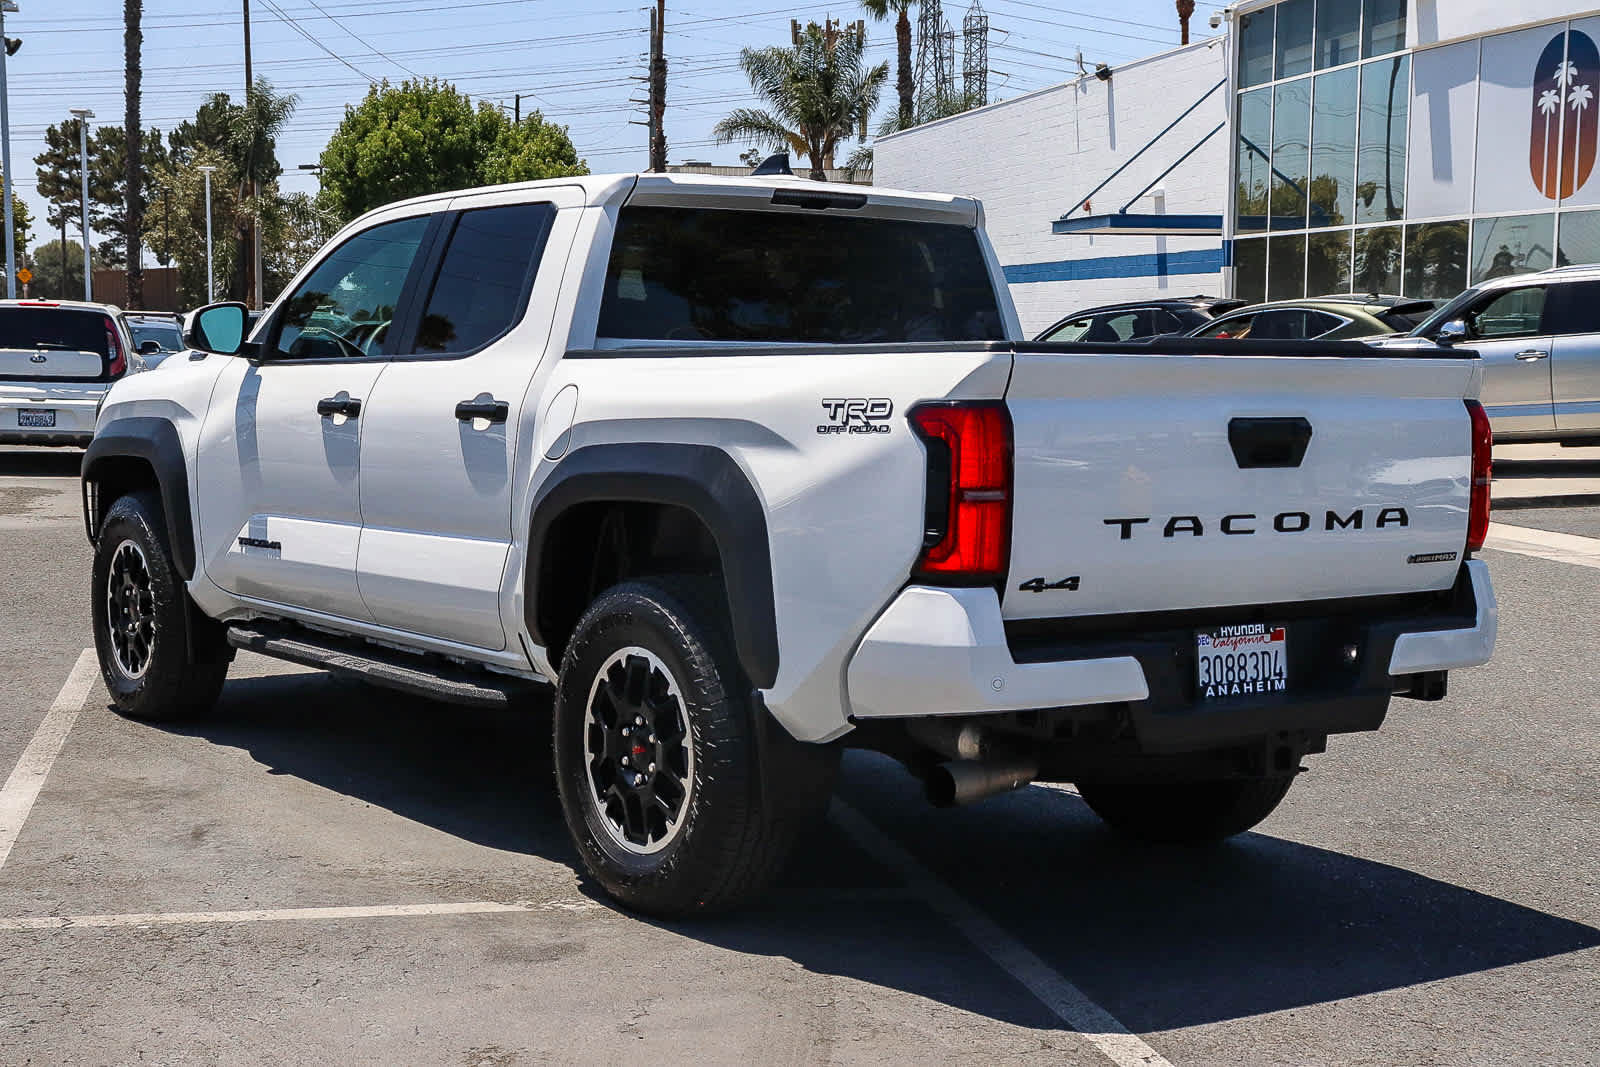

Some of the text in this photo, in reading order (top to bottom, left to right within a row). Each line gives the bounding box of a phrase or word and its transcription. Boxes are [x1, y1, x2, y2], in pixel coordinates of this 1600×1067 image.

[822, 398, 893, 426] TRD
[817, 424, 891, 434] OFF ROAD
[1103, 508, 1409, 539] TACOMA
[1220, 624, 1265, 638] HYUNDAI
[1200, 650, 1283, 686] 30883D4
[1206, 680, 1286, 697] ANAHEIM
